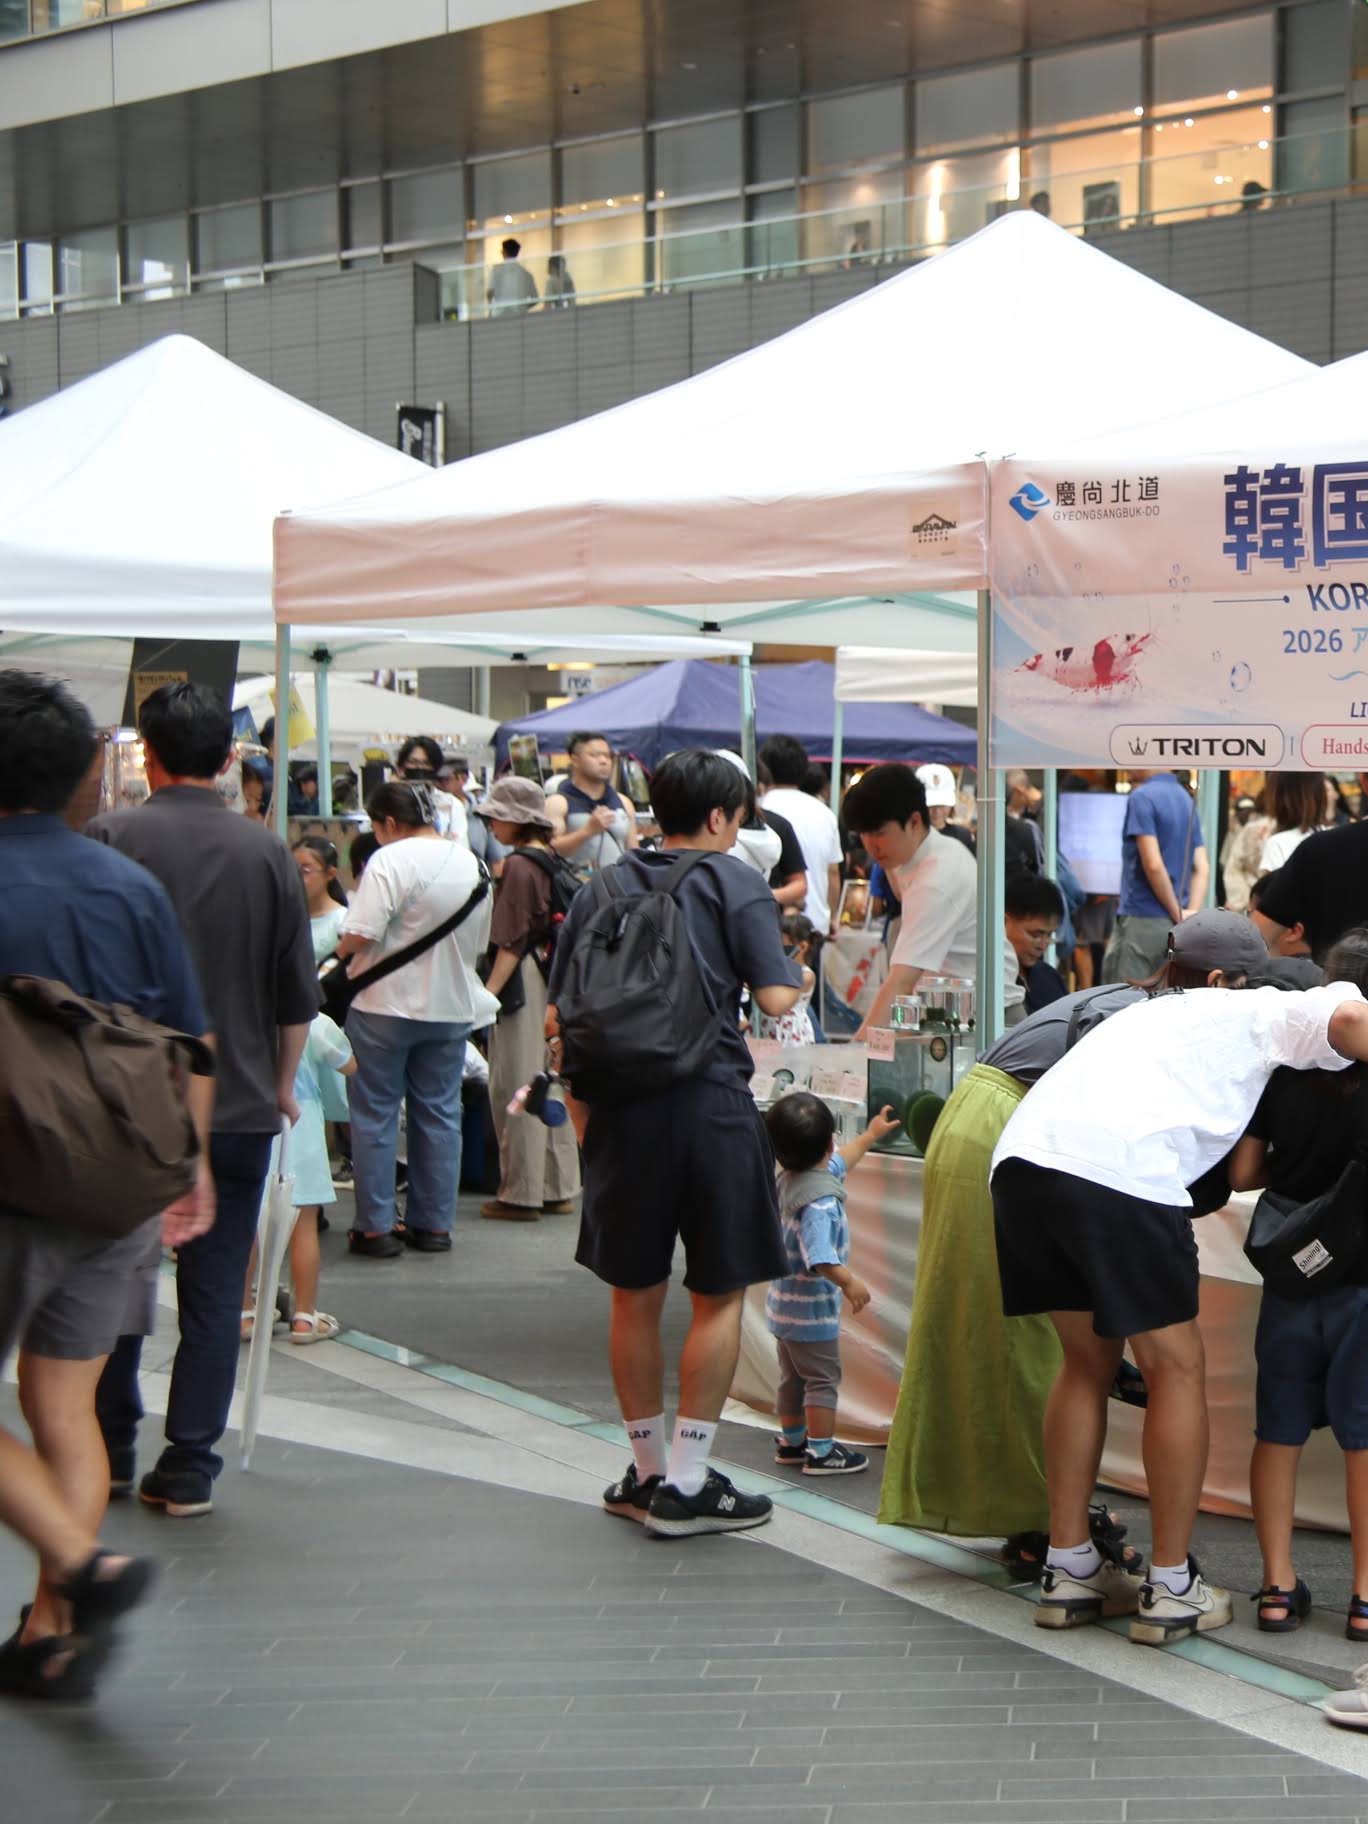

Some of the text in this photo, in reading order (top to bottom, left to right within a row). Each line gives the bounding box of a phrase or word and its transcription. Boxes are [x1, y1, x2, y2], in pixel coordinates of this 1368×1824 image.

[1056, 476, 1159, 506] 慶尚北道
[1052, 505, 1160, 520] GYEONGSANGBUK-DO
[1282, 628, 1344, 653] 2026
[1151, 738, 1266, 757] TRITON
[680, 1429, 707, 1441] GAP
